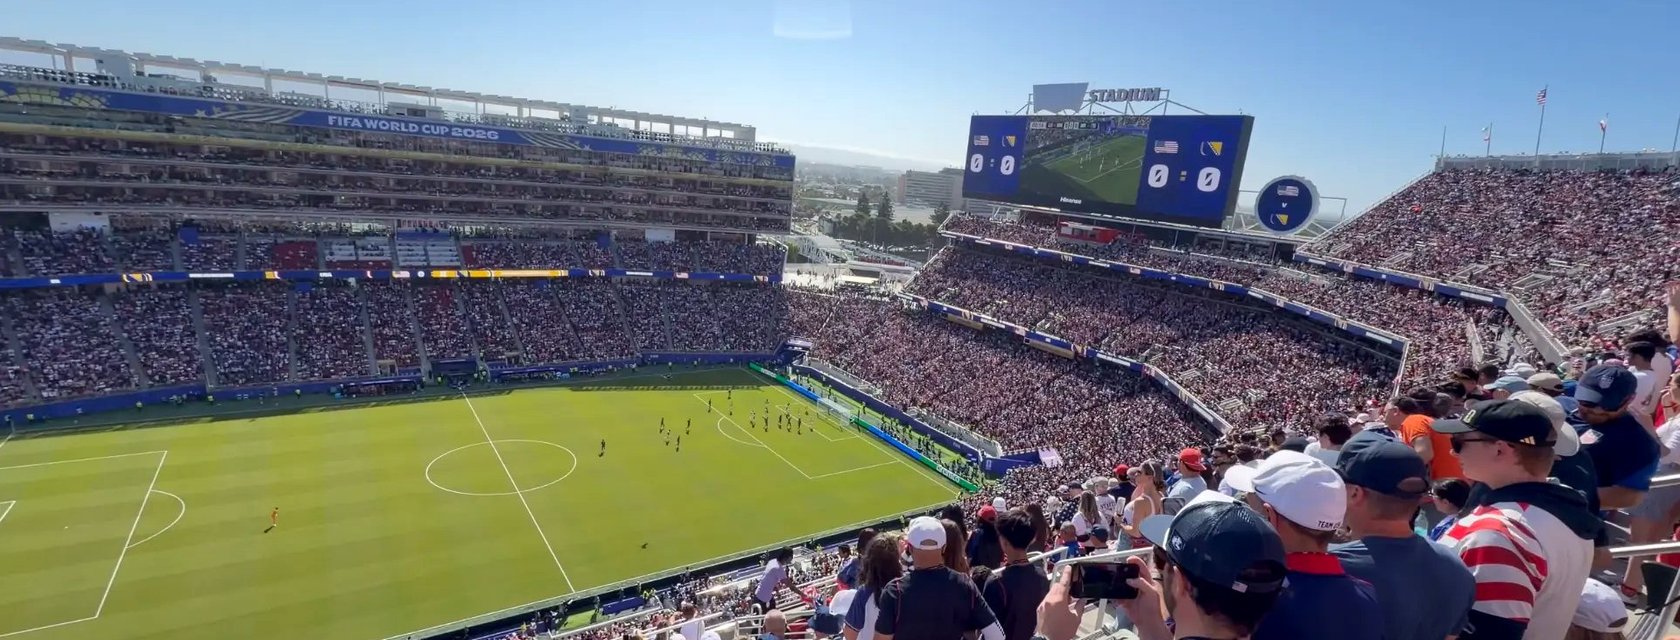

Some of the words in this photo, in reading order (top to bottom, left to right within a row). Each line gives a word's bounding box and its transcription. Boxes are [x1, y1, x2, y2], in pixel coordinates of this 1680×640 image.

[1088, 87, 1161, 103] STADIUM
[327, 115, 363, 129] FIFA
[363, 118, 419, 133] WORLD
[422, 124, 449, 136] CUP
[451, 127, 499, 140] 2026
[970, 153, 984, 173] 0
[1000, 155, 1015, 176] 0
[1147, 164, 1169, 188] 0
[1196, 166, 1221, 192] 0
[1318, 520, 1334, 529] TEAM
